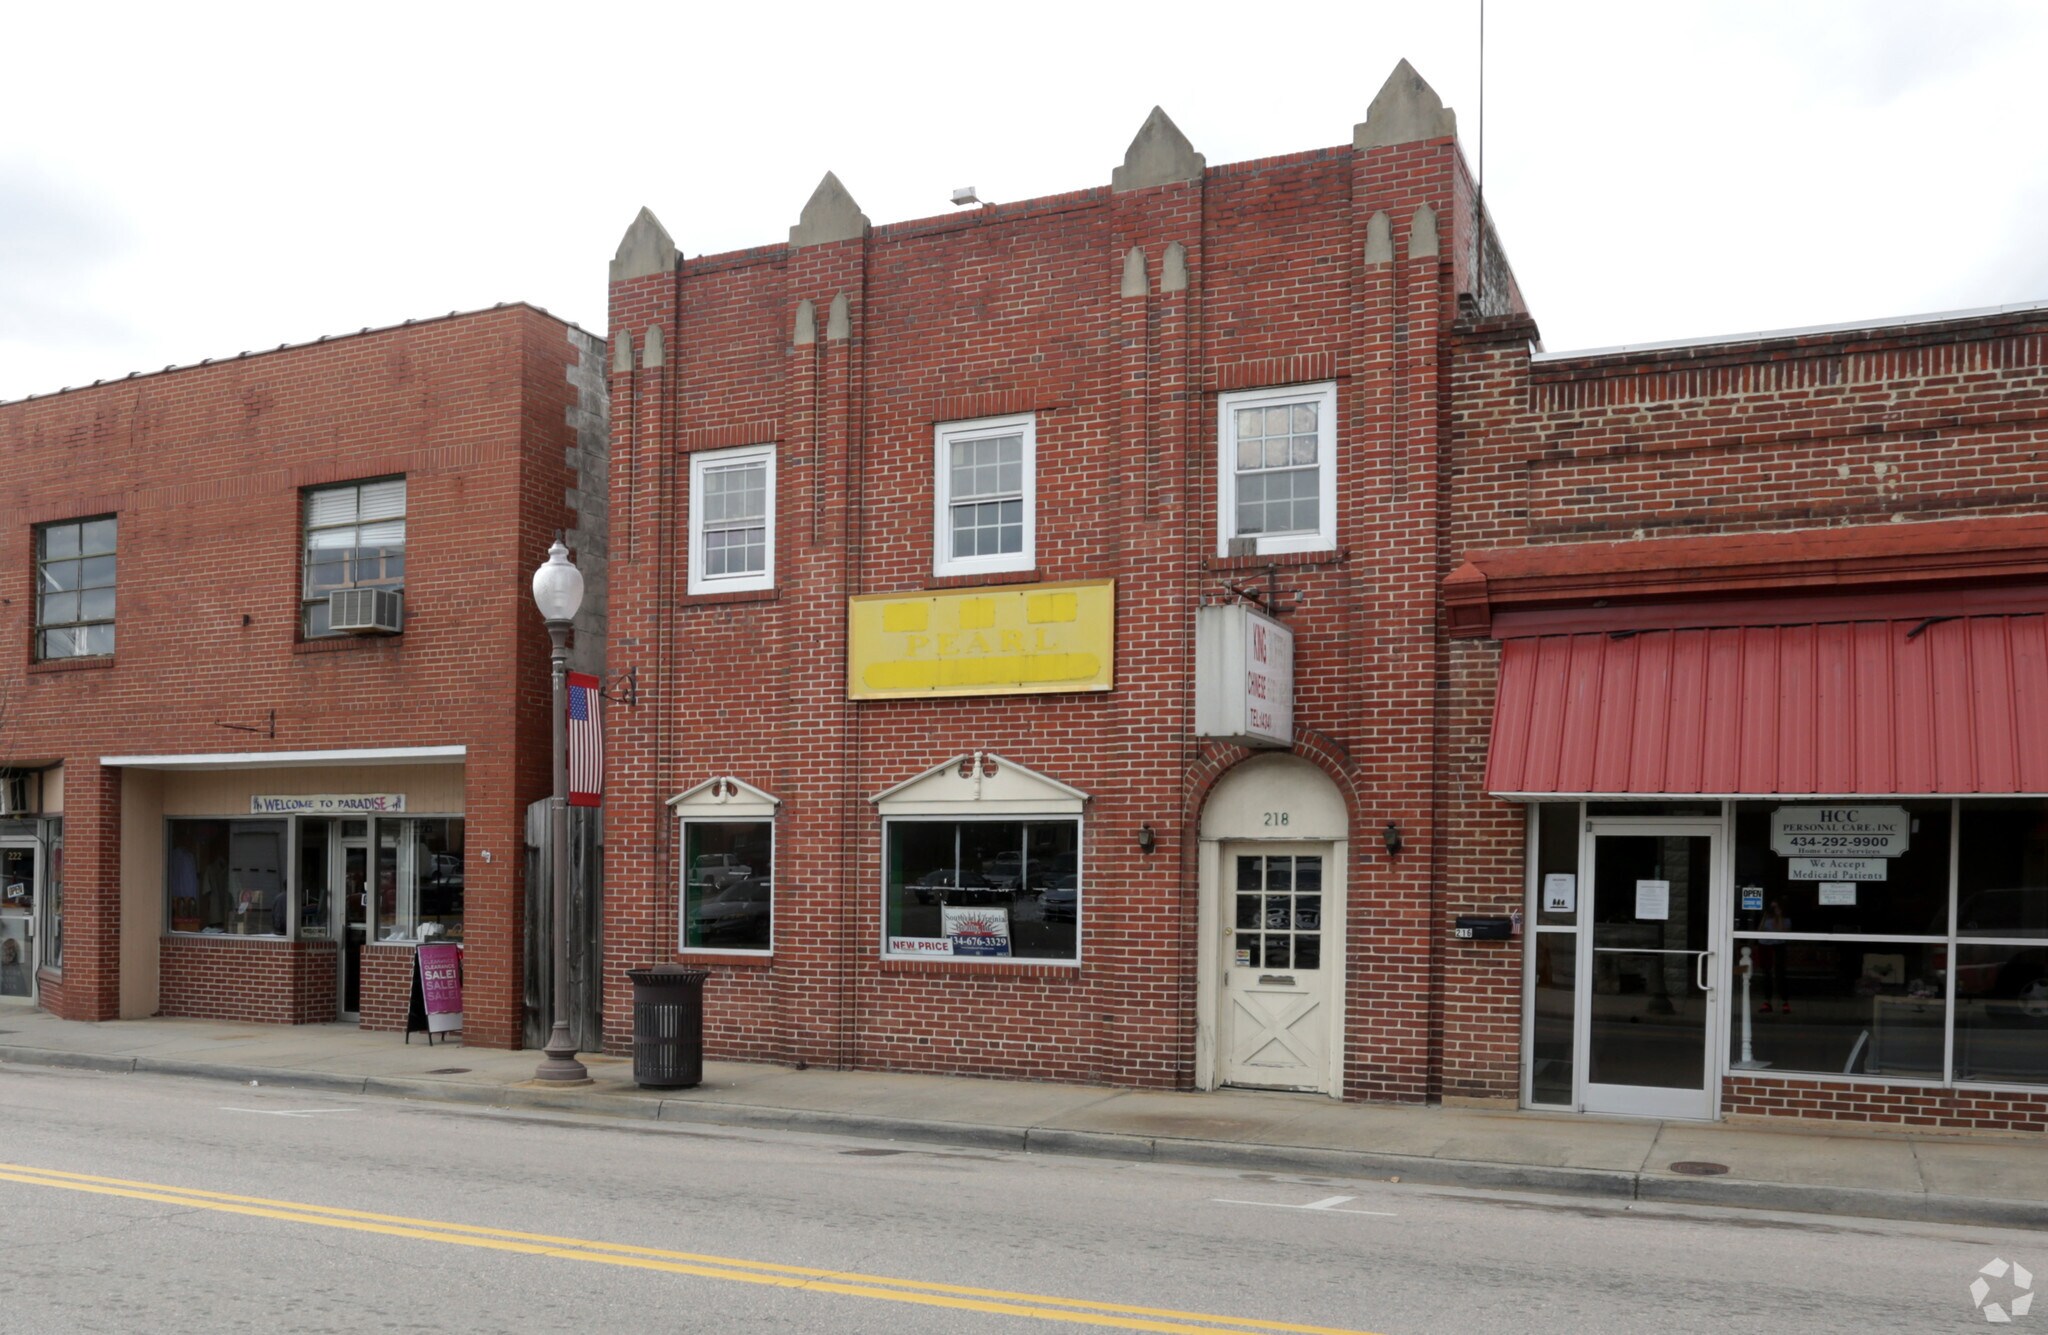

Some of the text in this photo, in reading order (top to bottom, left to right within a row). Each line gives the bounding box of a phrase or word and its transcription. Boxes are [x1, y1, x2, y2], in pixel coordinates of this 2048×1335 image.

[905, 628, 1059, 657] PEARL
[1253, 623, 1267, 664] KING
[1248, 670, 1266, 699] CHINESE
[264, 797, 386, 810] WELCOME TO PARADISE
[1263, 812, 1289, 826] 218
[1820, 810, 1859, 823] HCC
[1783, 823, 1839, 832] PERSONAL
[1790, 837, 1889, 847] 434-292-9900
[8, 852, 22, 860] 222
[1810, 859, 1866, 870] We Accept
[1793, 870, 1883, 879] Medicaid Patients
[9, 885, 23, 896] OPEN
[1743, 890, 1761, 898] OPEN
[1456, 929, 1472, 937] 216
[893, 941, 949, 951] NEW PRICE
[950, 936, 1006, 946] 34-676-3329
